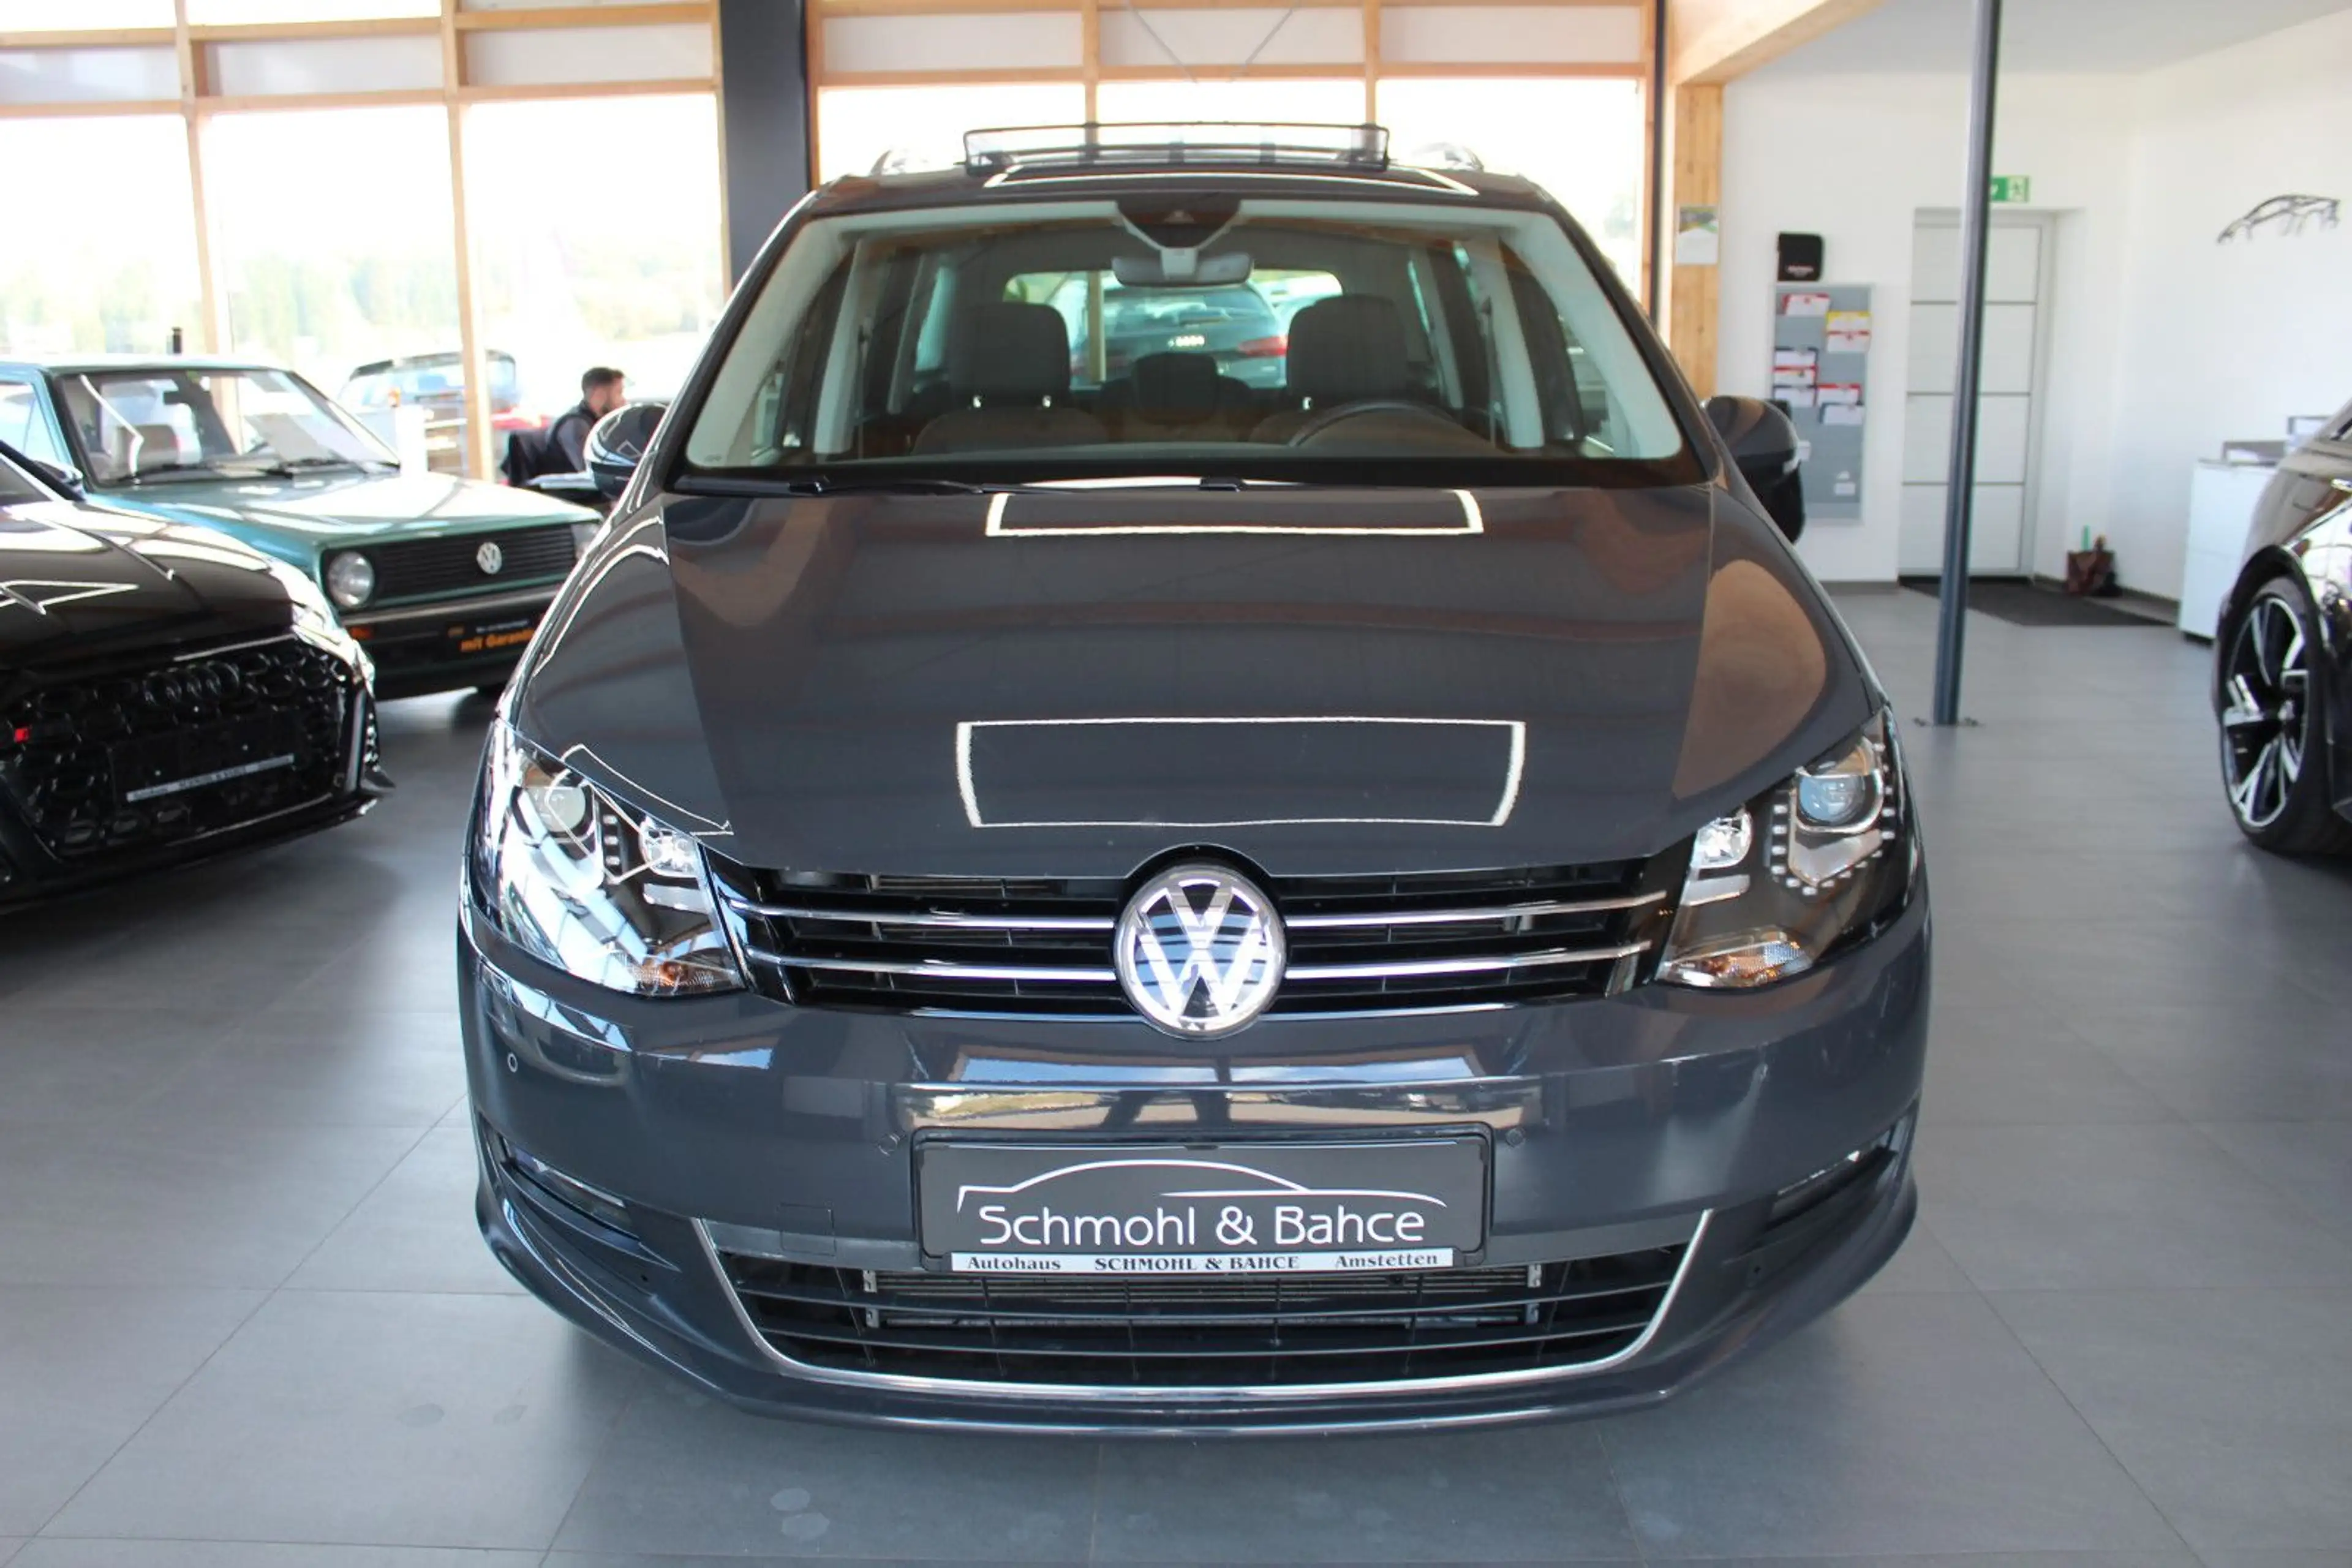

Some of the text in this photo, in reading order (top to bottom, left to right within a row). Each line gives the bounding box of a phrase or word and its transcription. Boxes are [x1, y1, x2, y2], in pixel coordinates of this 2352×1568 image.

[979, 1204, 1425, 1246] Schmohl & Bahce
[967, 1253, 1439, 1272] Autohaus SCHMOHL & BAHCE Amstetten
